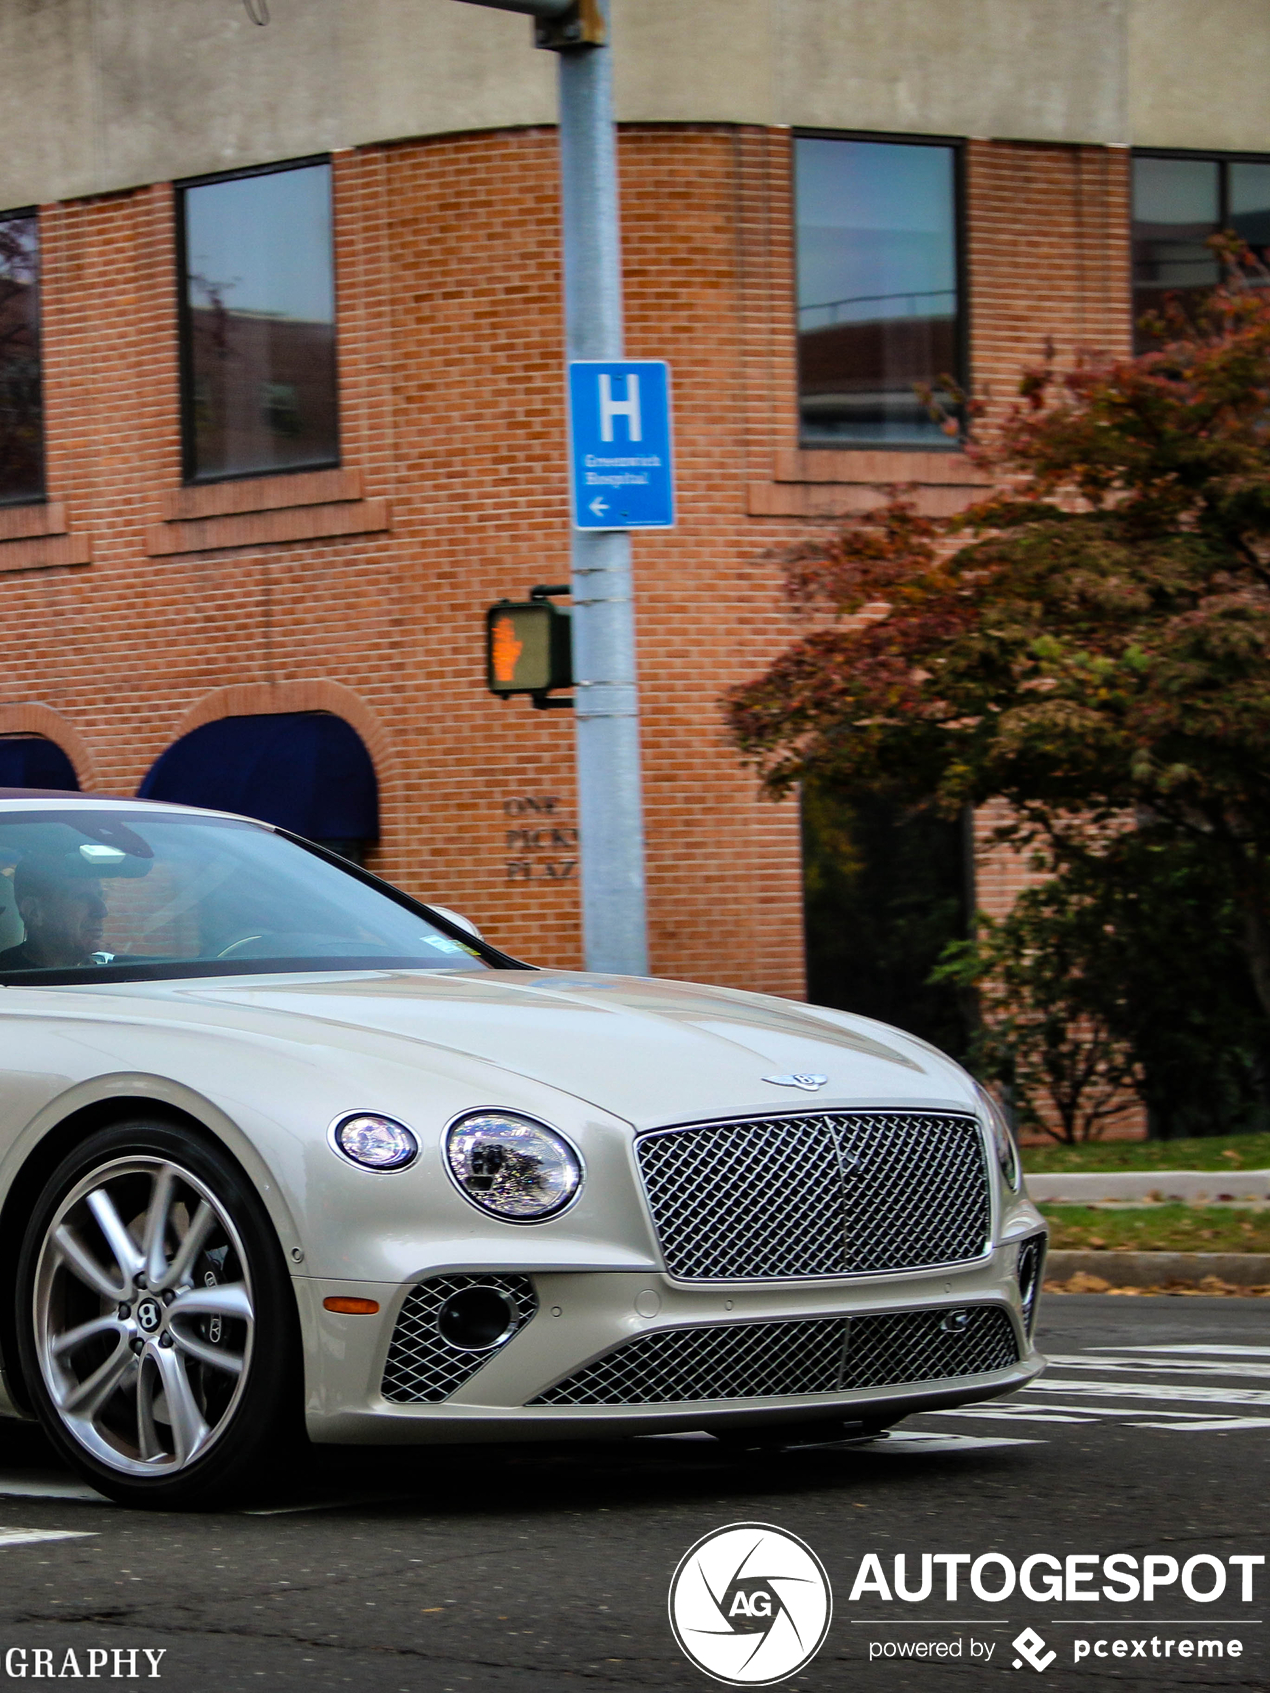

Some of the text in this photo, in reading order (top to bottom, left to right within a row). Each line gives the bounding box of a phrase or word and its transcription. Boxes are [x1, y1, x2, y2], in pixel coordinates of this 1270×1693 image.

[598, 373, 642, 442] H
[585, 472, 649, 488] Hospital
[504, 796, 561, 817] ONE
[505, 860, 580, 880] PLAZ
